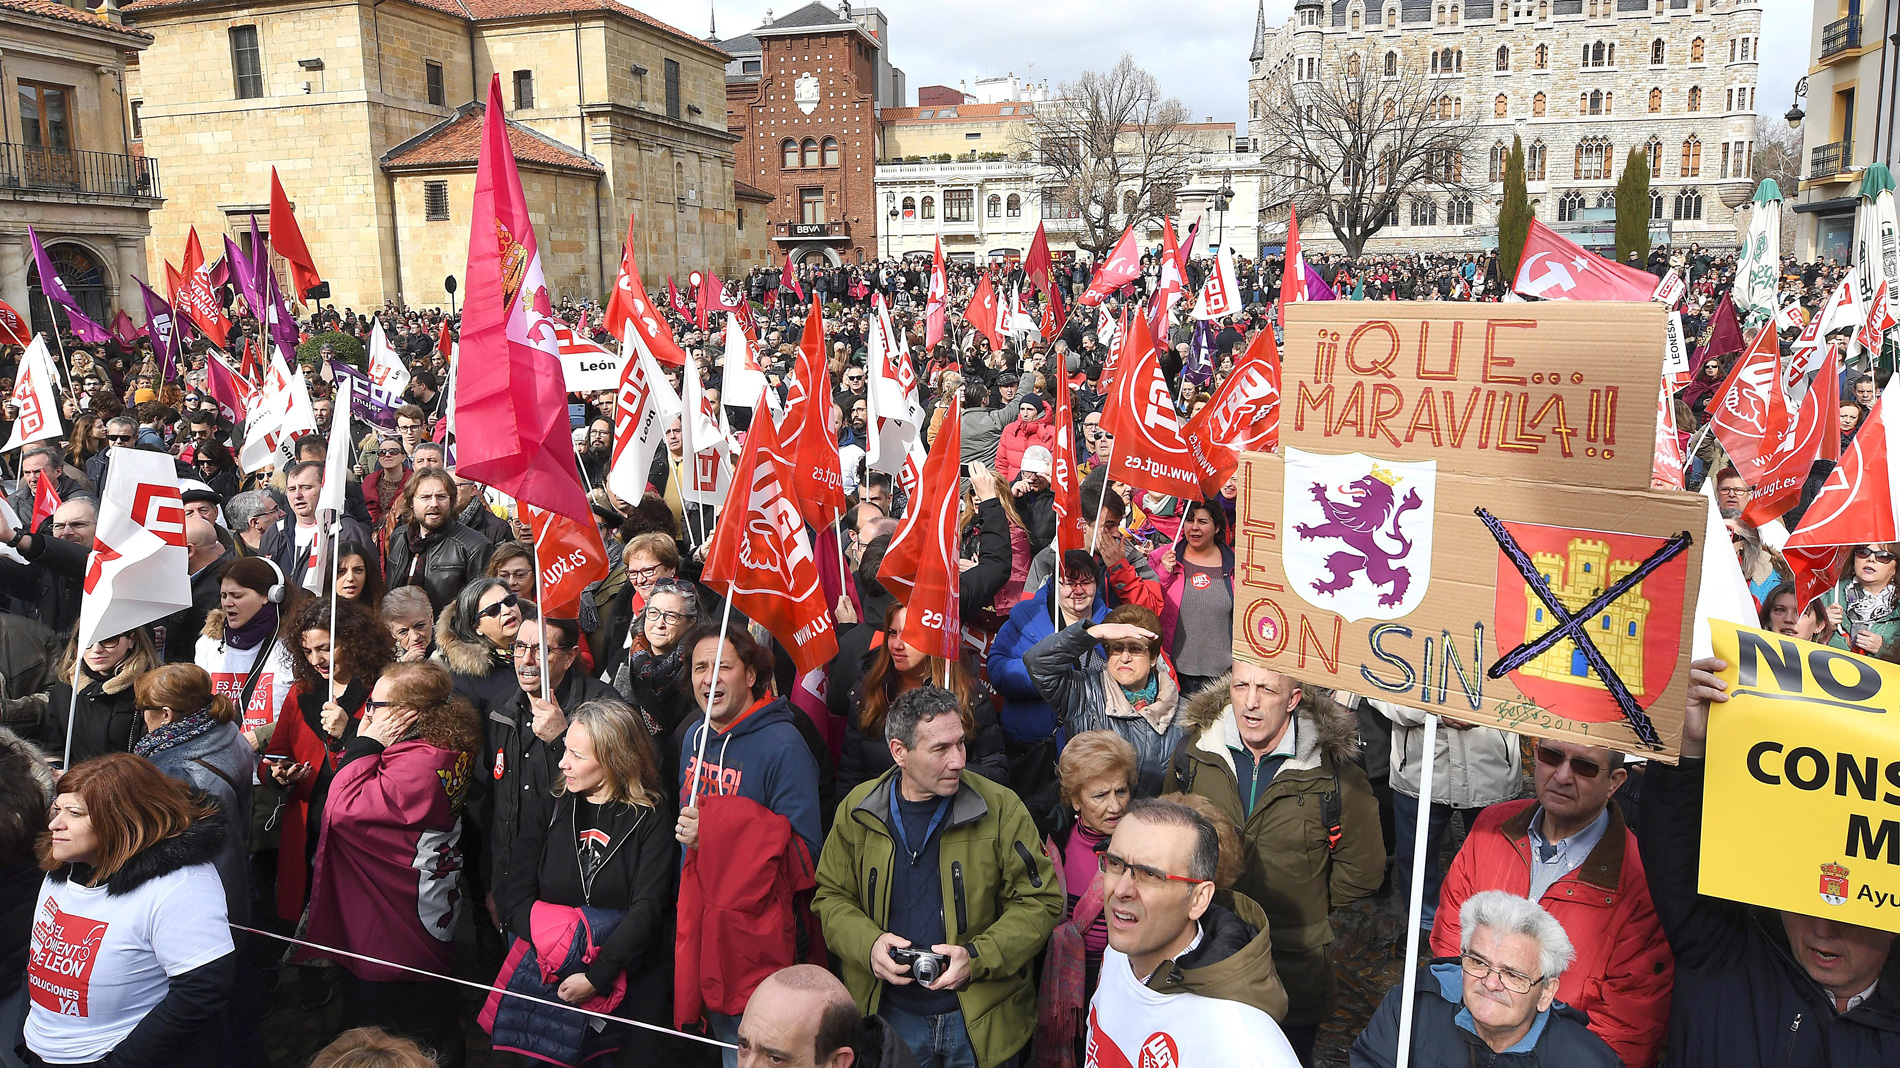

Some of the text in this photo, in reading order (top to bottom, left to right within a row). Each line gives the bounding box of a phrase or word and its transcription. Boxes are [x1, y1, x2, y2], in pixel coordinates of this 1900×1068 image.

[796, 225, 820, 234] BBVA
[1667, 318, 1681, 365] LEONESA
[580, 359, 617, 372] León
[352, 396, 382, 413] mujer
[639, 408, 656, 444] León
[1360, 621, 1485, 711] SIN
[1736, 629, 1882, 701] NO
[1540, 715, 1589, 737] 2019
[29, 973, 80, 1001] SOLUCIONES
[59, 998, 80, 1017] YA
